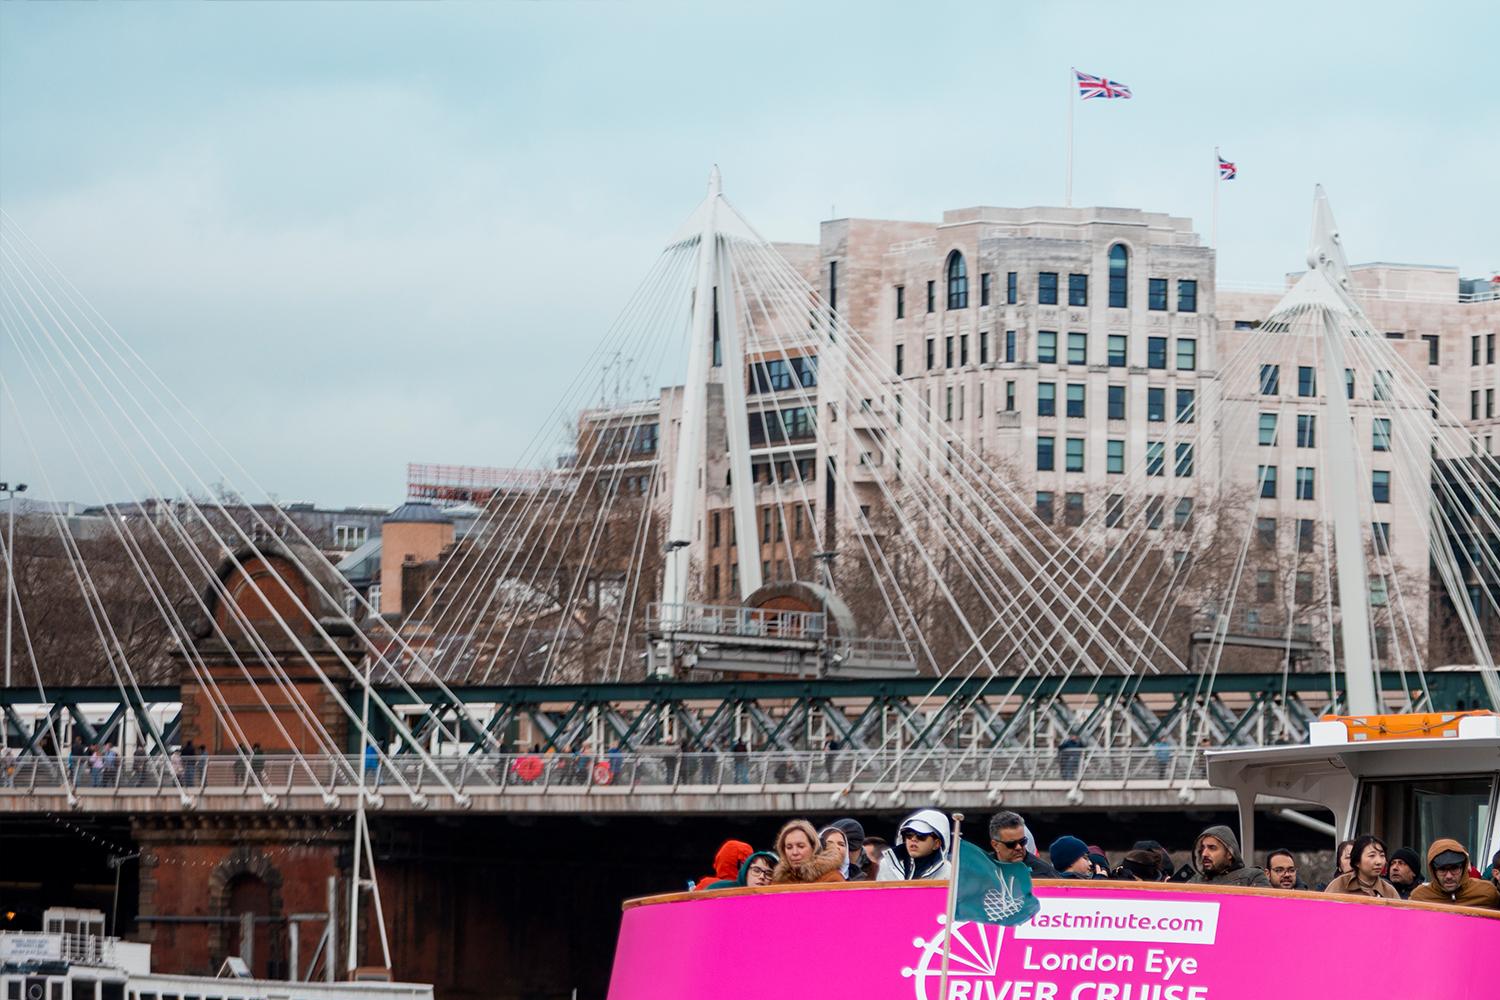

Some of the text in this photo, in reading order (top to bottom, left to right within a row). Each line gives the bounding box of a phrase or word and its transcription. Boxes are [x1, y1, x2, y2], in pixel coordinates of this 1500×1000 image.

[1030, 911, 1204, 932] lastminute.com
[1023, 946, 1198, 980] London Eye
